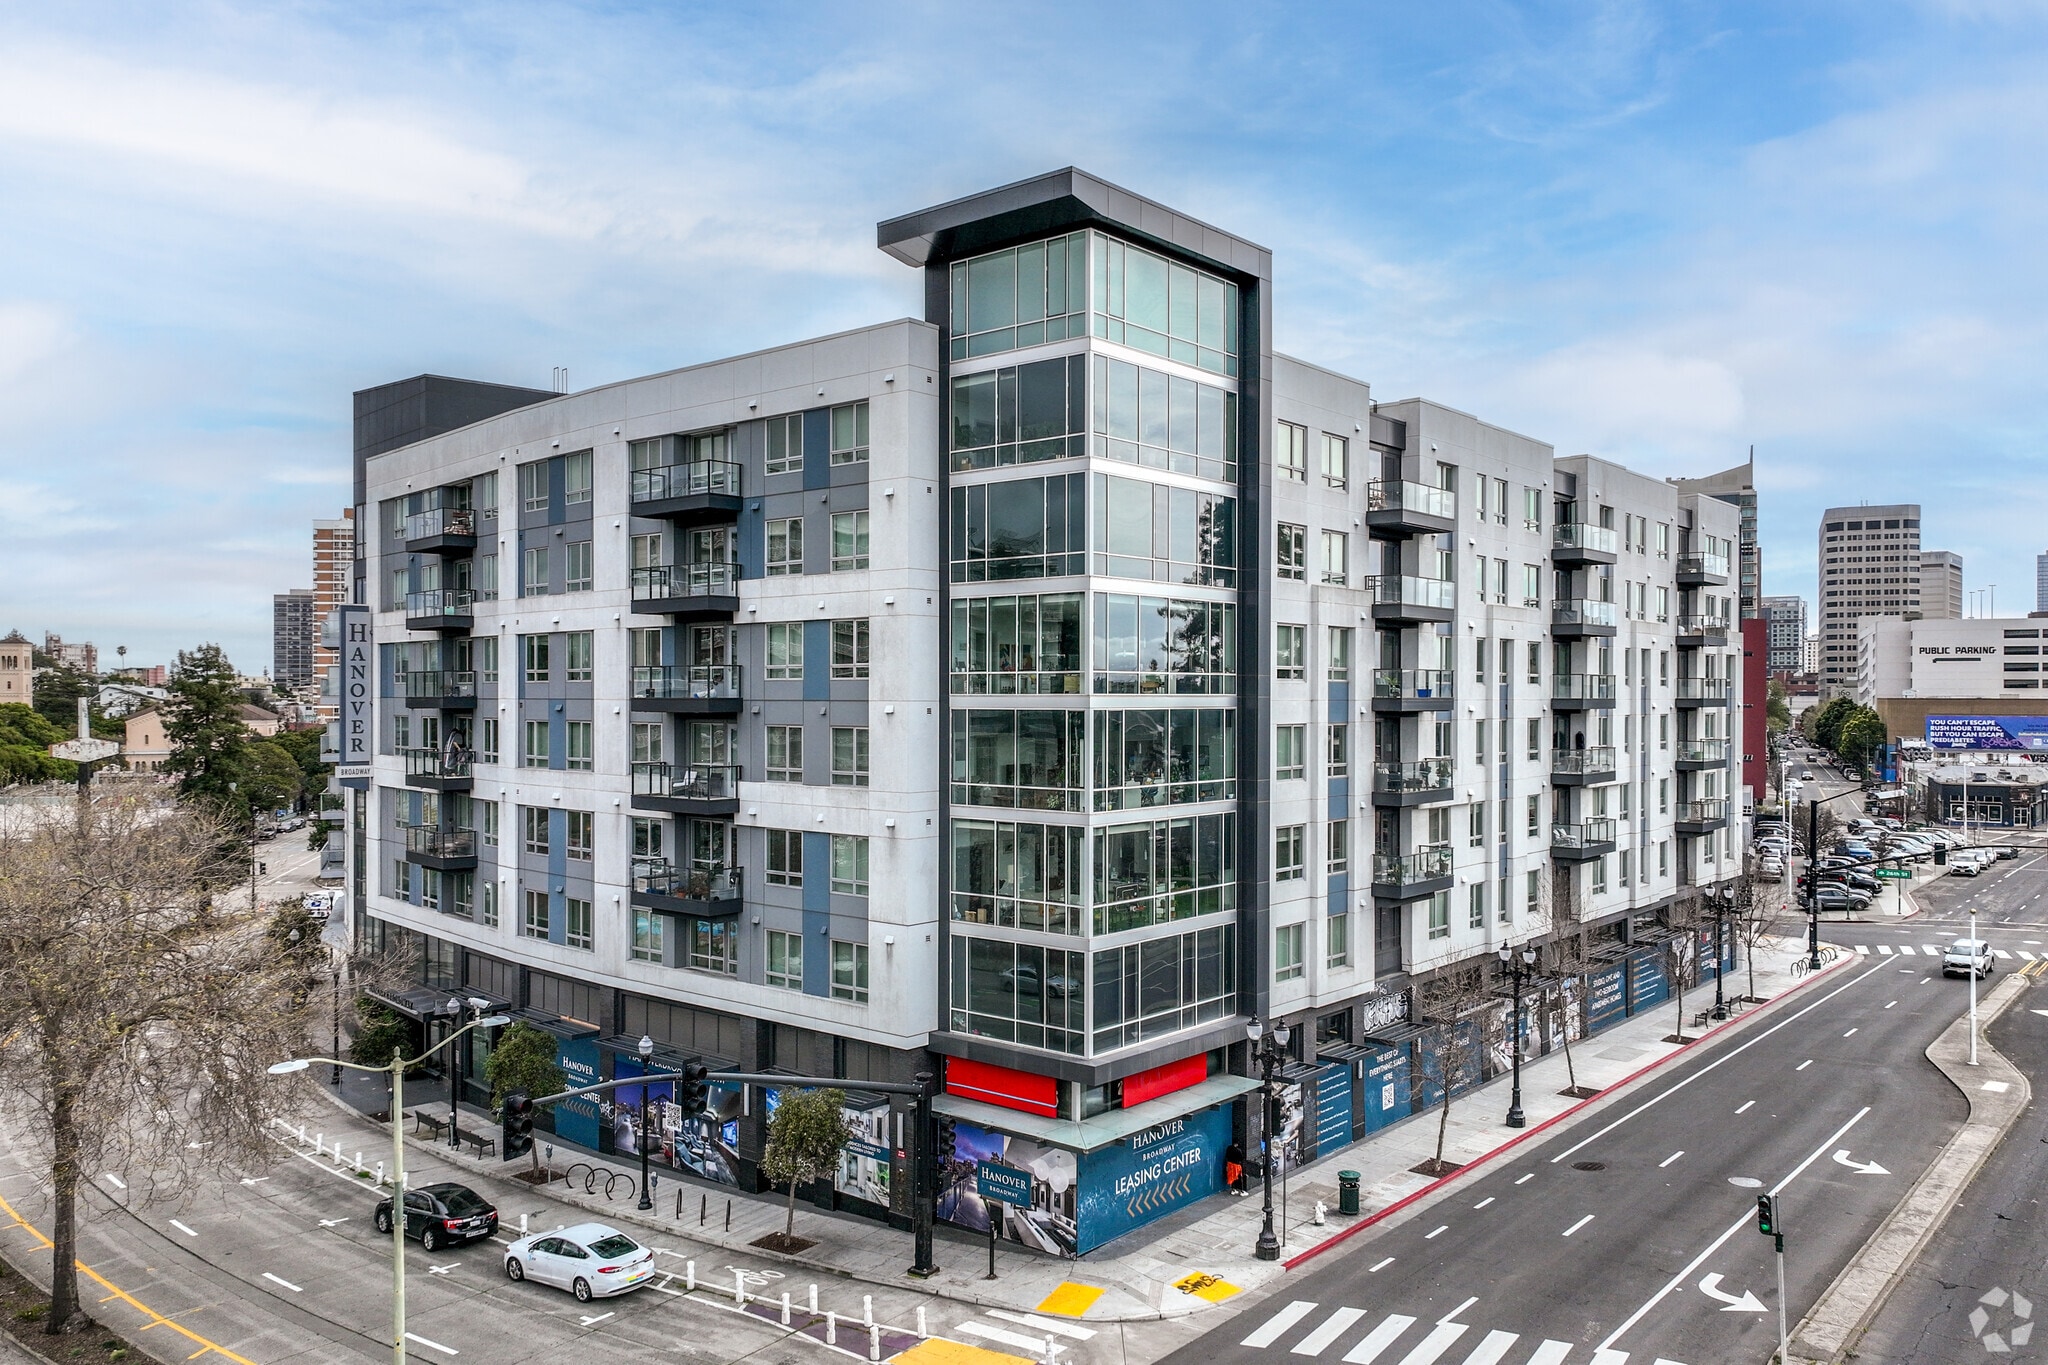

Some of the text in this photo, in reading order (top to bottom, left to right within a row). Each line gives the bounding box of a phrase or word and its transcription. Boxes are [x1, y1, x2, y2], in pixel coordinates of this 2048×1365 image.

[1955, 646, 1997, 654] PARKING
[349, 623, 367, 752] HANOVER
[341, 768, 371, 776] BROADWAY
[563, 1056, 594, 1076] HANOVER
[1133, 1119, 1184, 1150] HANOVER
[1142, 1143, 1175, 1161] BROADWAY
[981, 1166, 1027, 1190] HANOVER
[1115, 1147, 1201, 1195] LEASING CENTER
[989, 1185, 1018, 1198] BROADWAY
